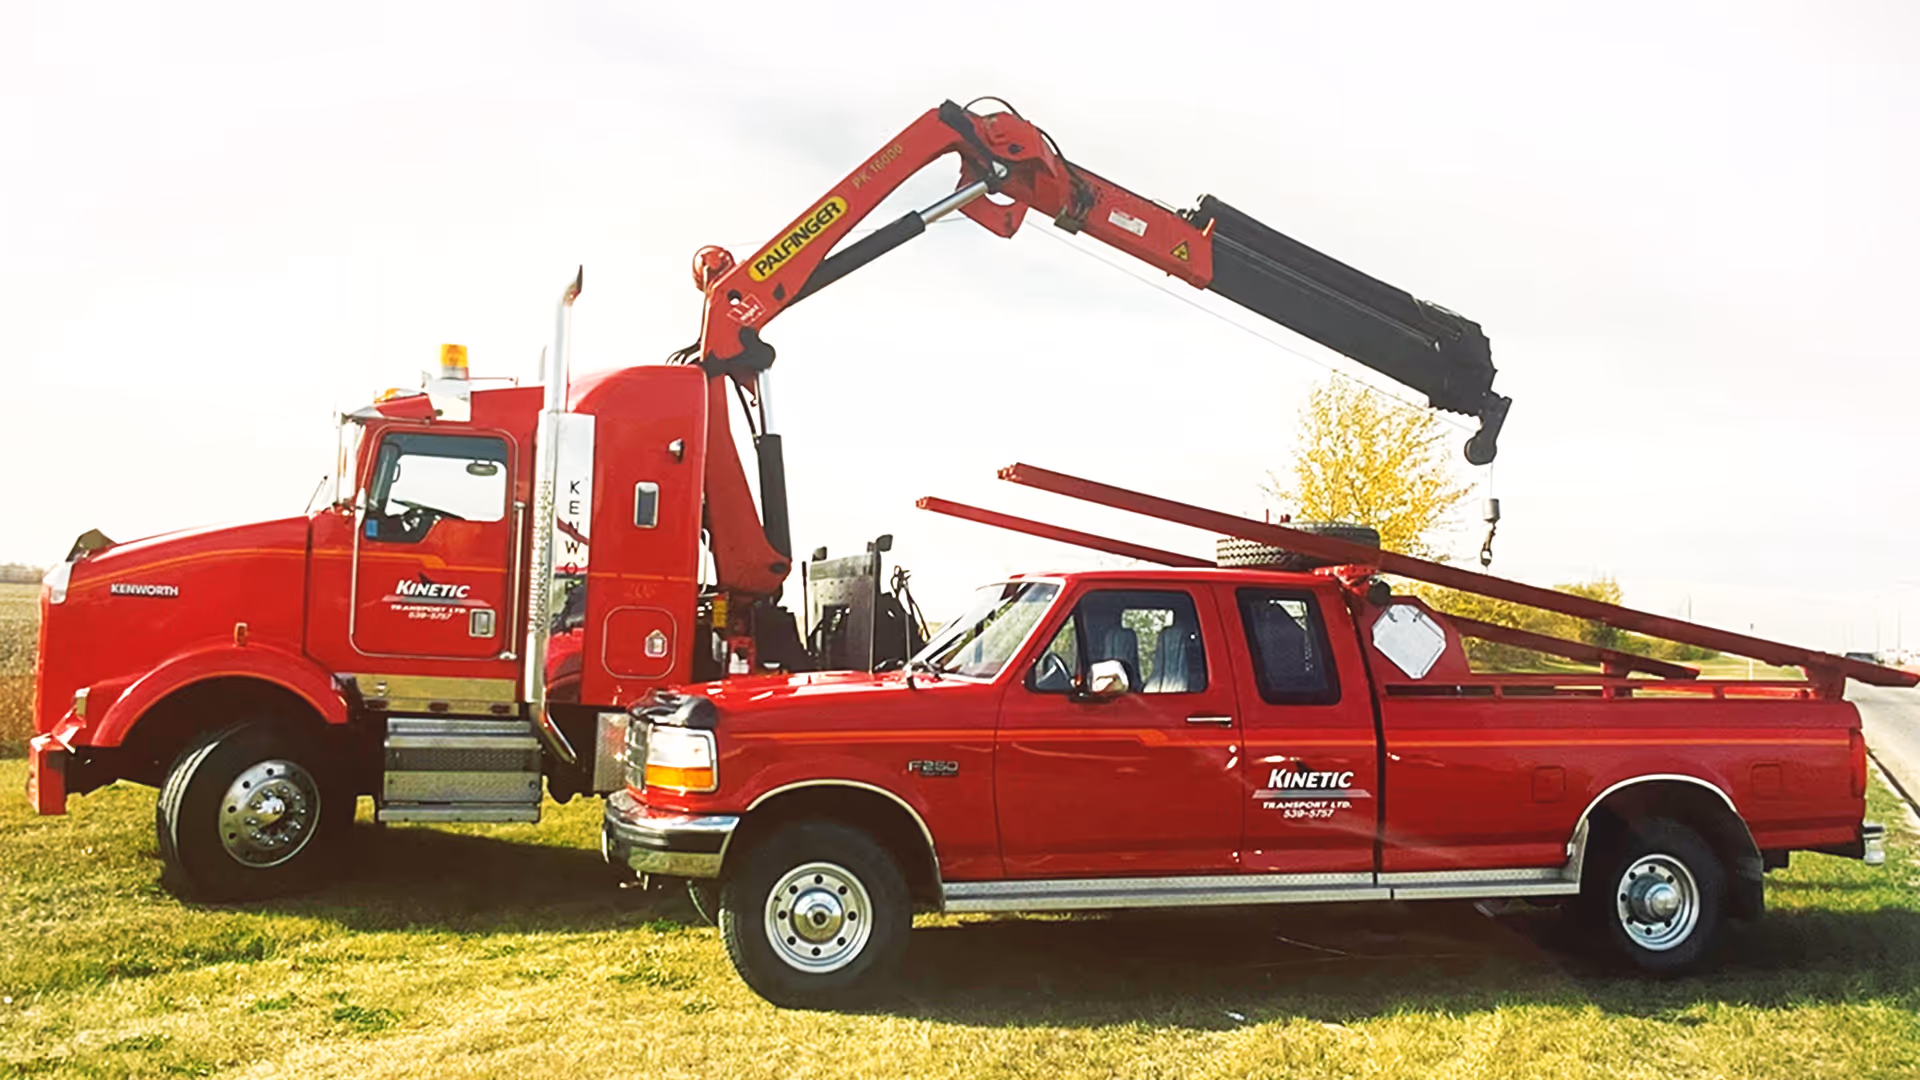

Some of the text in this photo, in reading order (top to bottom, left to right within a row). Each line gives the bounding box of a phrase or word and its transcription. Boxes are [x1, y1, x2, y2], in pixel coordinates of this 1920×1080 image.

[870, 144, 903, 173] 16000
[754, 202, 841, 276] PALFINGER
[110, 583, 179, 596] KENWORTH
[395, 580, 471, 598] KINETIC
[908, 760, 959, 771] F250
[1268, 768, 1355, 788] KINETIC
[1263, 801, 1328, 809] TRANSPORT
[1283, 809, 1334, 818] 539-5757
